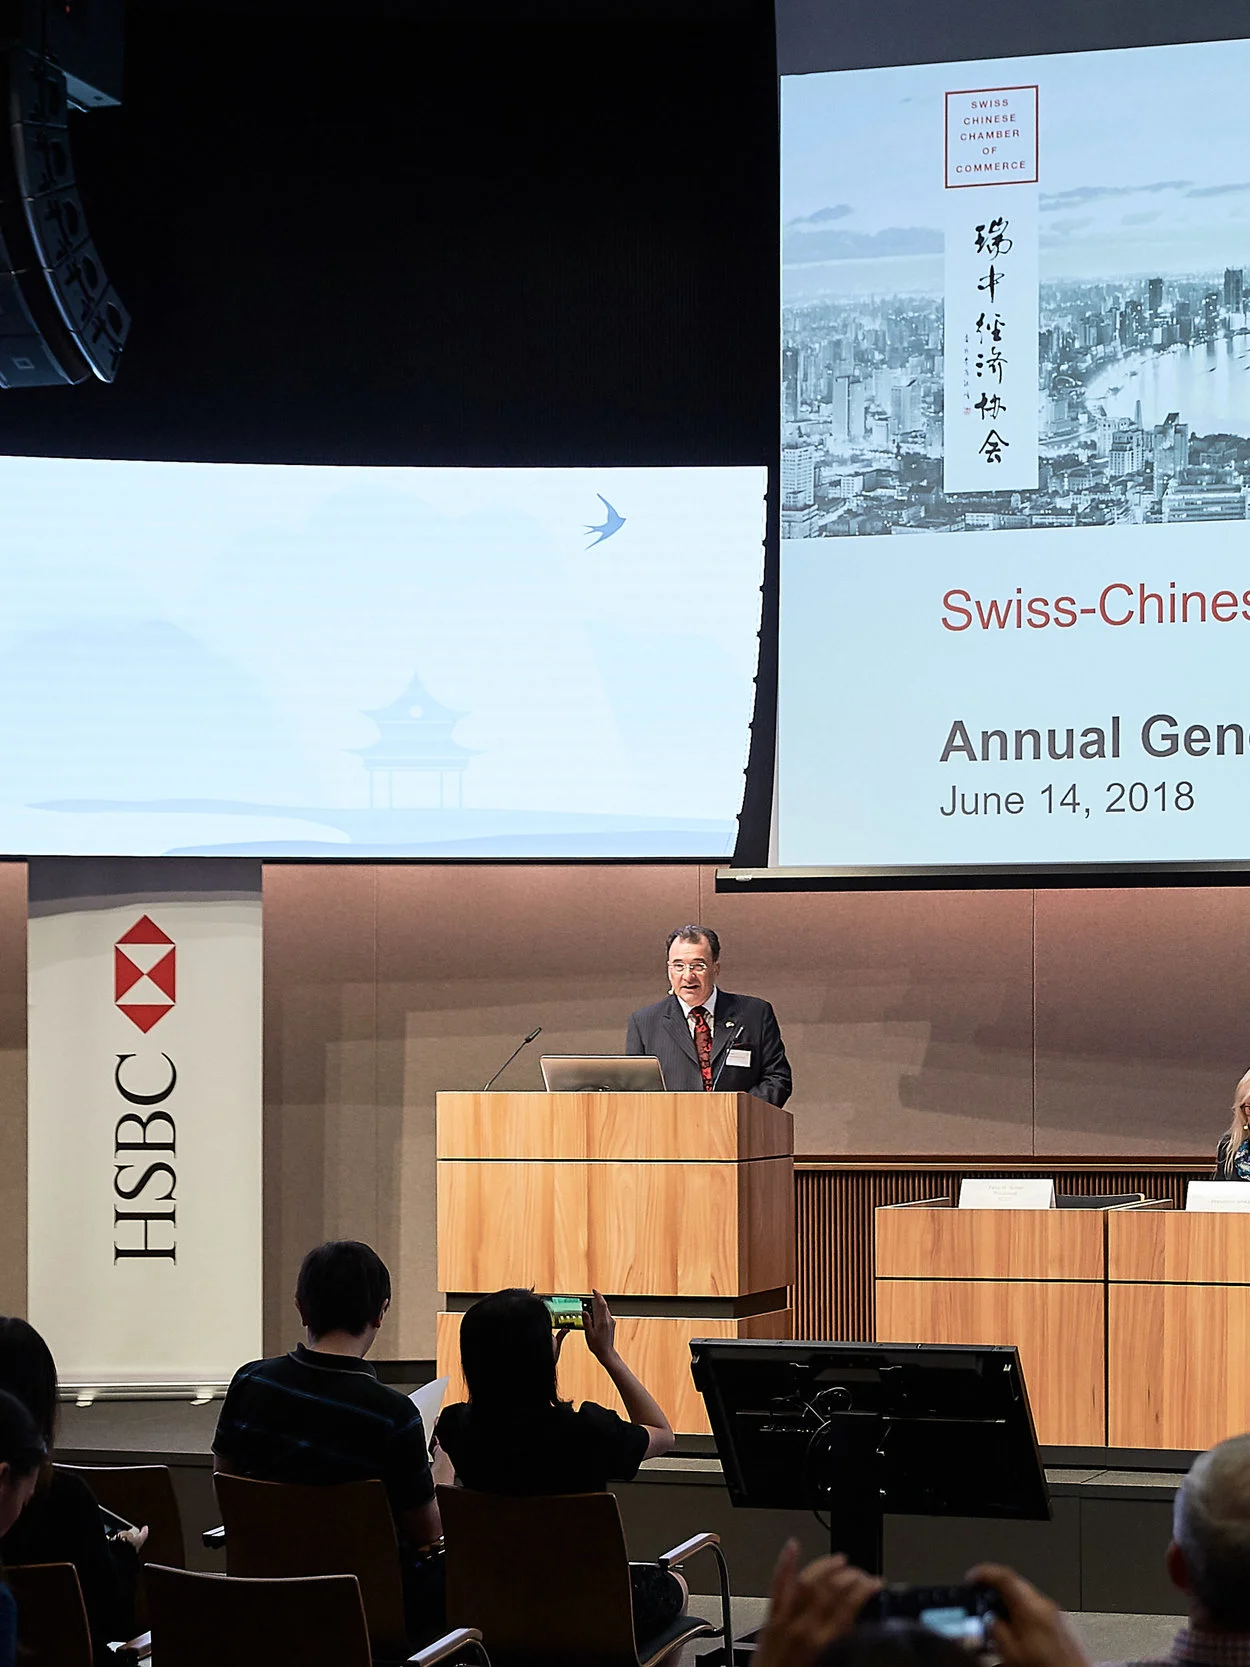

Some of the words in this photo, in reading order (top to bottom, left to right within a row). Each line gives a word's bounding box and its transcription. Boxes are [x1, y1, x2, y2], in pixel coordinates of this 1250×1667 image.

[971, 99, 1009, 109] SWISS
[963, 113, 1016, 125] CHINESE
[960, 129, 1020, 141] CHAMBER
[982, 146, 997, 155] OF
[956, 161, 1026, 173] COMMERCE
[940, 716, 1120, 763] Annual
[940, 785, 1025, 817] June
[1040, 784, 1090, 819] 14,
[1105, 780, 1195, 813] 2018
[113, 1052, 178, 1266] HSBC
